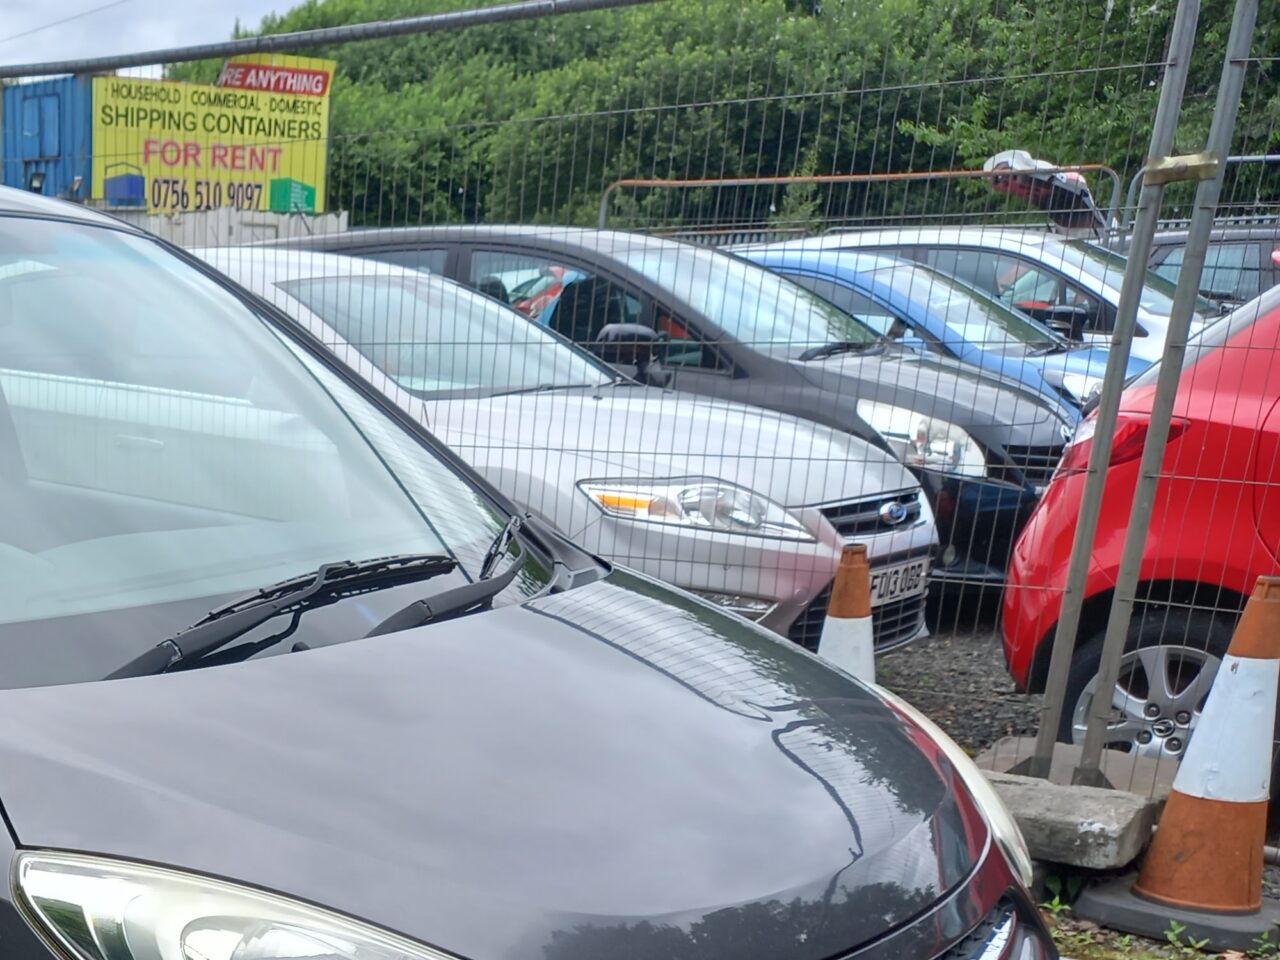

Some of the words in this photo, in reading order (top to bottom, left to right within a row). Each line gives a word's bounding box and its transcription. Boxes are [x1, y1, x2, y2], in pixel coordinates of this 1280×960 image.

[245, 67, 324, 93] ANYTHING
[111, 82, 181, 104] HOUSEHOLD
[190, 89, 261, 112] COMMERCIAL
[270, 97, 322, 117] DOMESTIC
[101, 104, 197, 133] SHIPPING
[202, 112, 321, 140] CONTAINERS
[143, 140, 201, 169] FOR
[211, 145, 283, 173] RENT
[151, 178, 189, 209] 0756
[195, 181, 221, 211] 510
[227, 182, 263, 211] 9097
